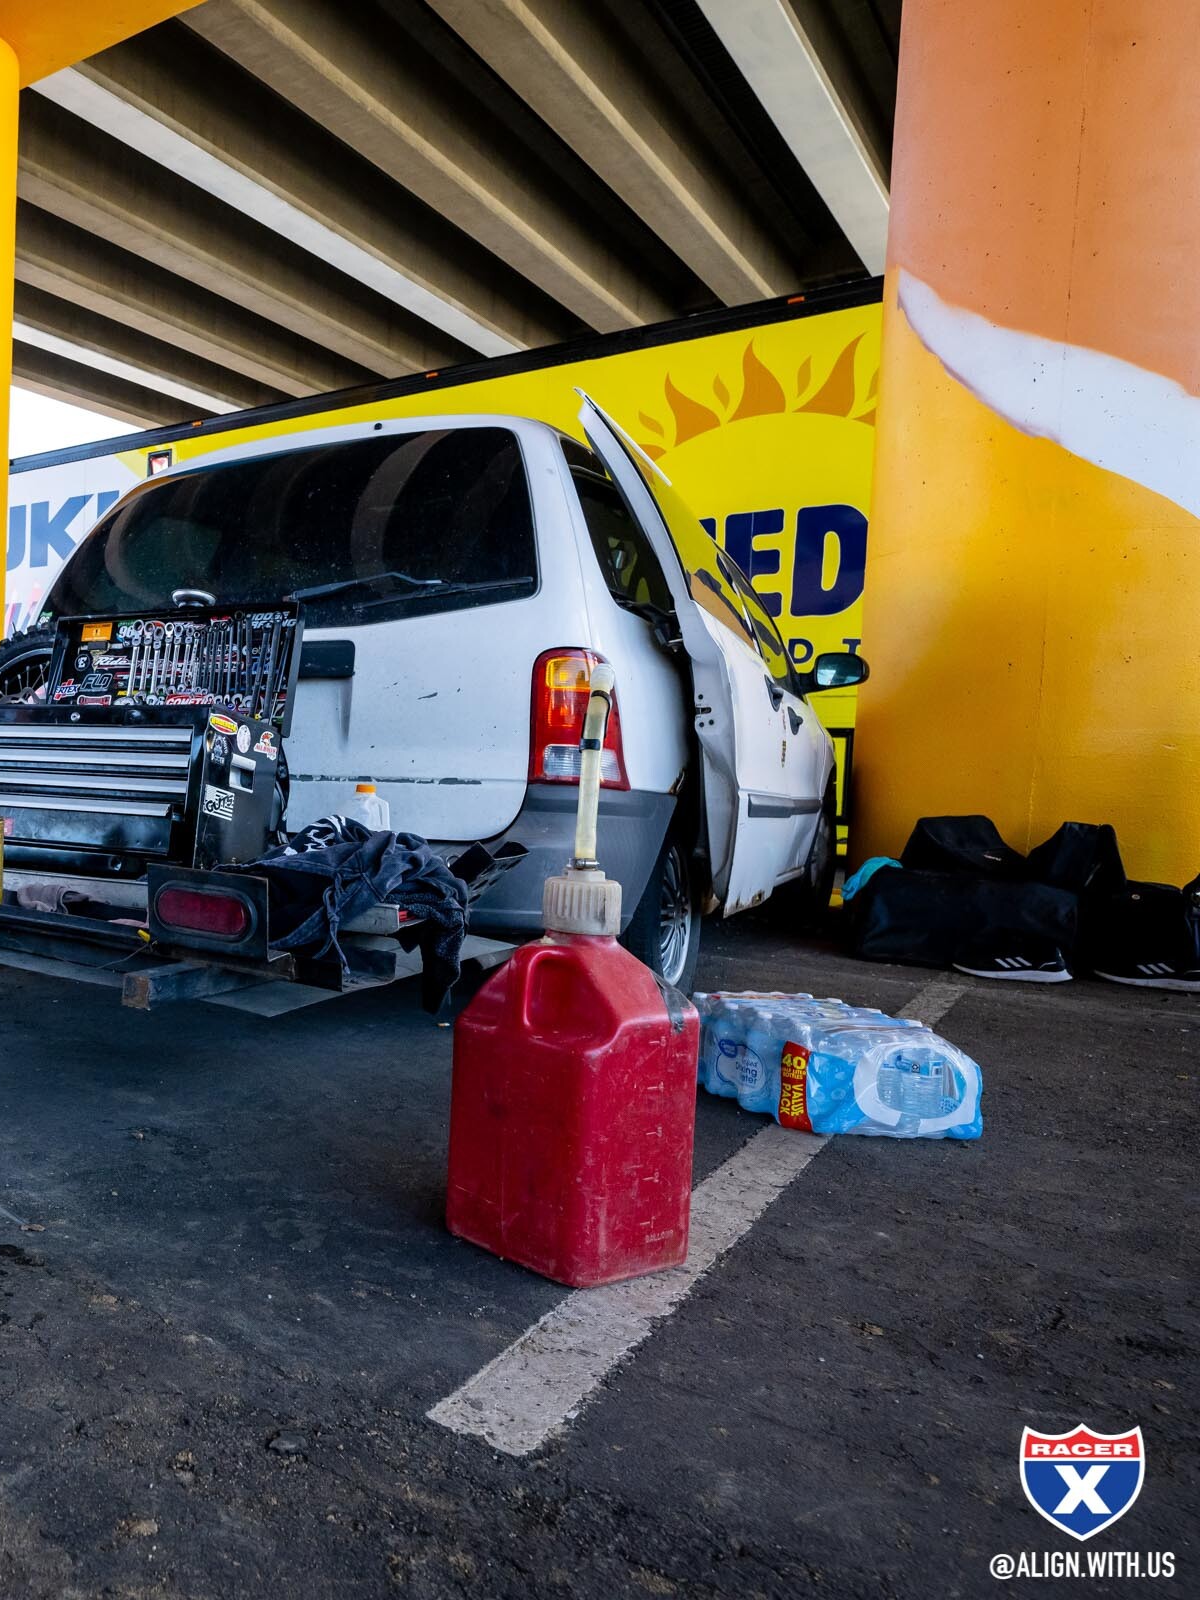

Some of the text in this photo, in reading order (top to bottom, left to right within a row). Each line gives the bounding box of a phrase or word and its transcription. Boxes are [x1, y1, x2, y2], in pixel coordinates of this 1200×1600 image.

[698, 503, 868, 618] ED
[55, 684, 80, 694] ERTEX
[81, 673, 113, 690] FLO
[205, 794, 234, 812] GUTS
[782, 1053, 807, 1070] 40
[780, 1082, 792, 1116] PACK
[790, 1083, 804, 1117] VALUE
